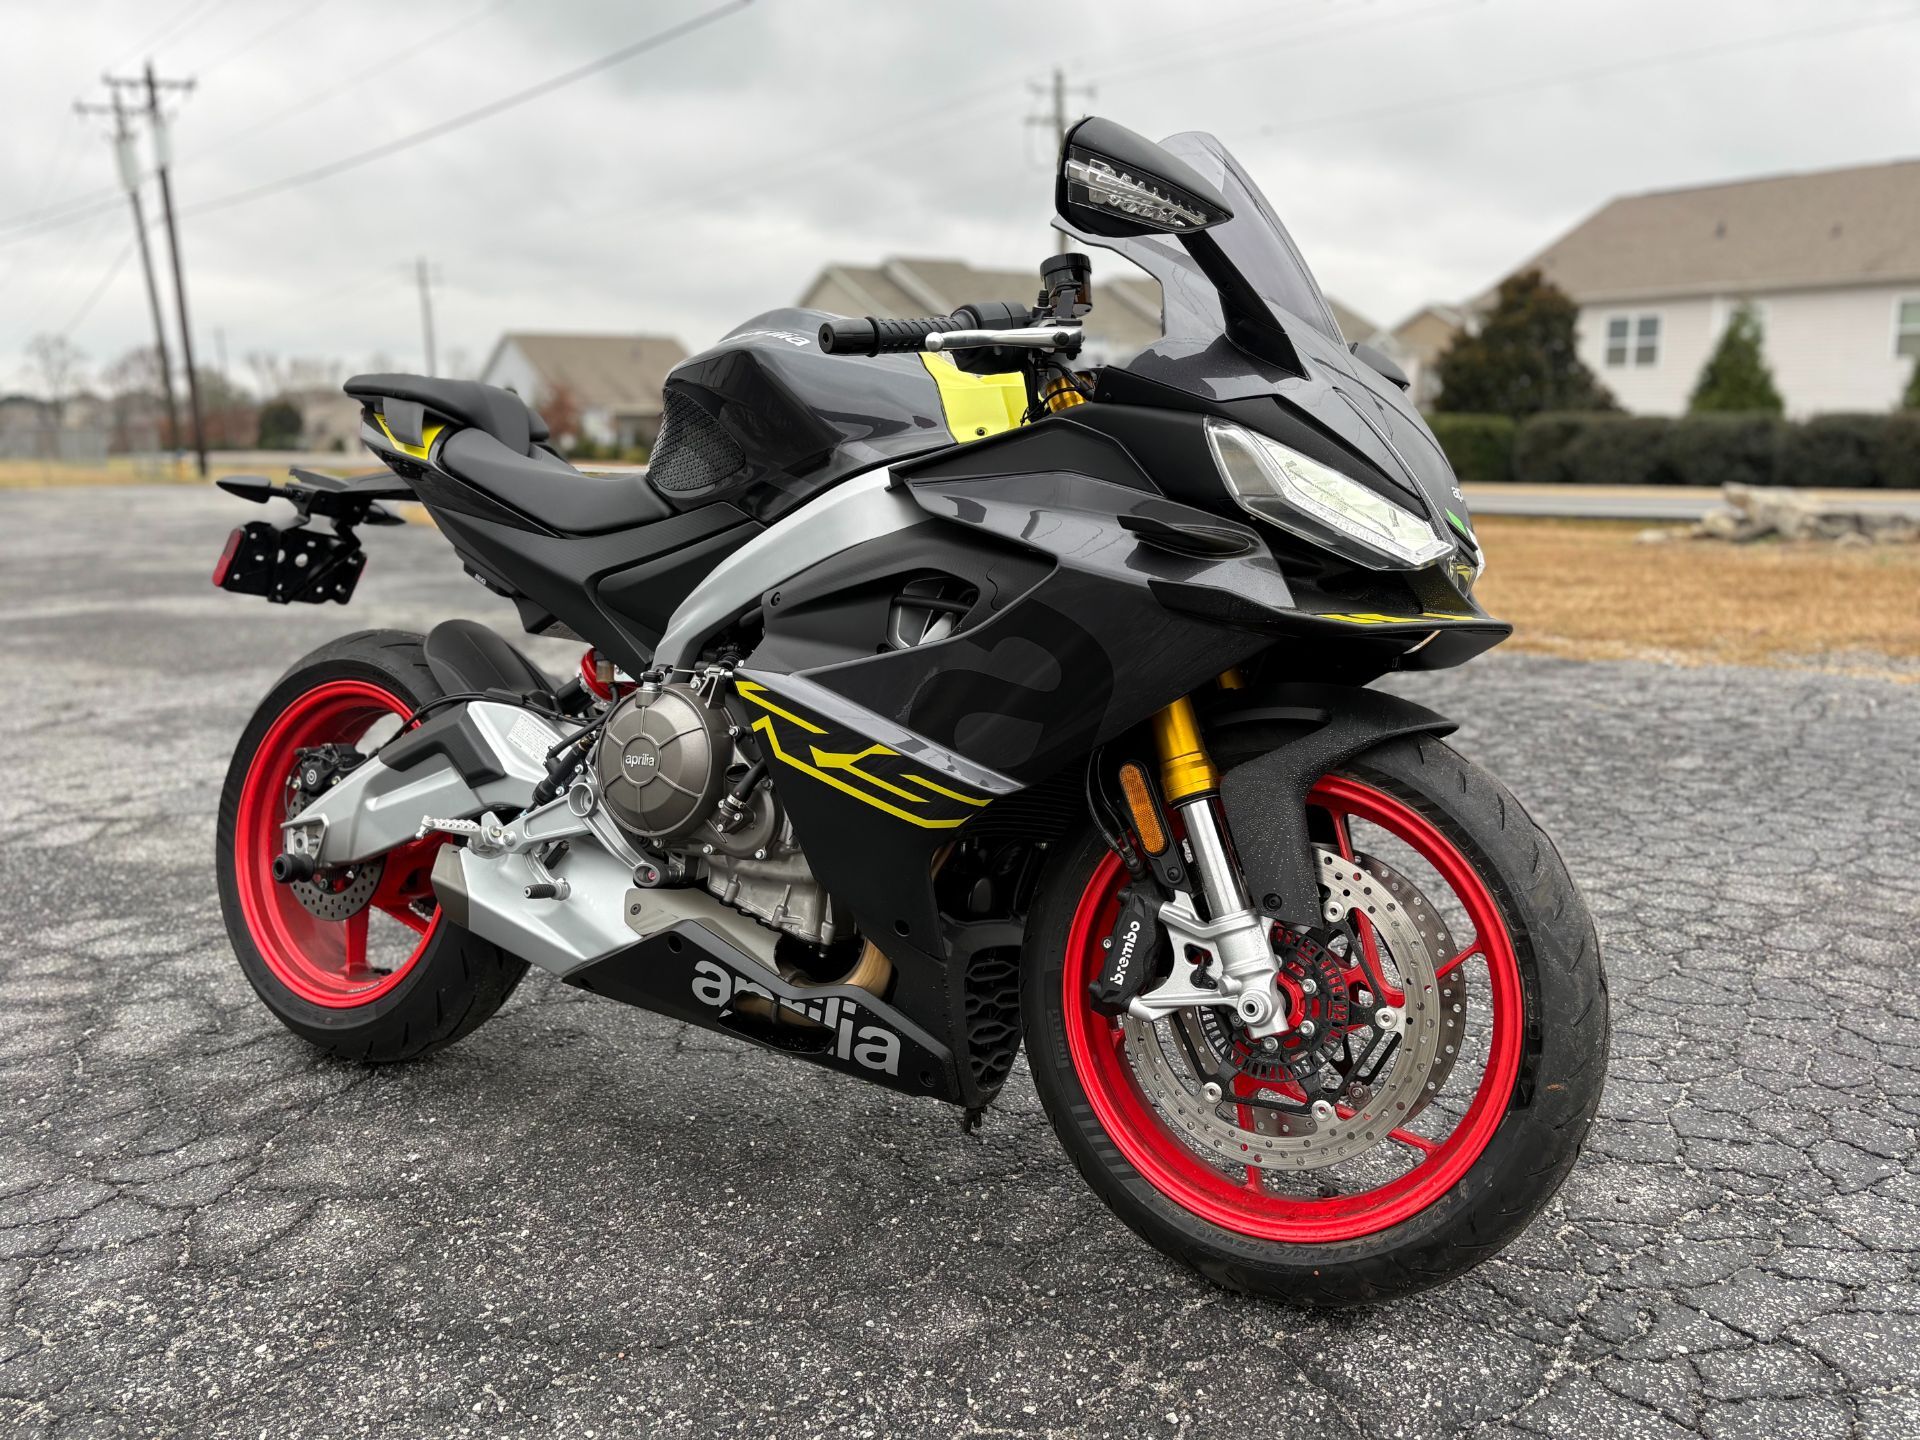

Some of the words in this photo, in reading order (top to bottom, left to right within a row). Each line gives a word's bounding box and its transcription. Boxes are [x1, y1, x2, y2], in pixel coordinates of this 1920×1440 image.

[625, 753, 655, 767] aprilia
[1109, 920, 1141, 986] brembo
[691, 960, 901, 1077] alia
